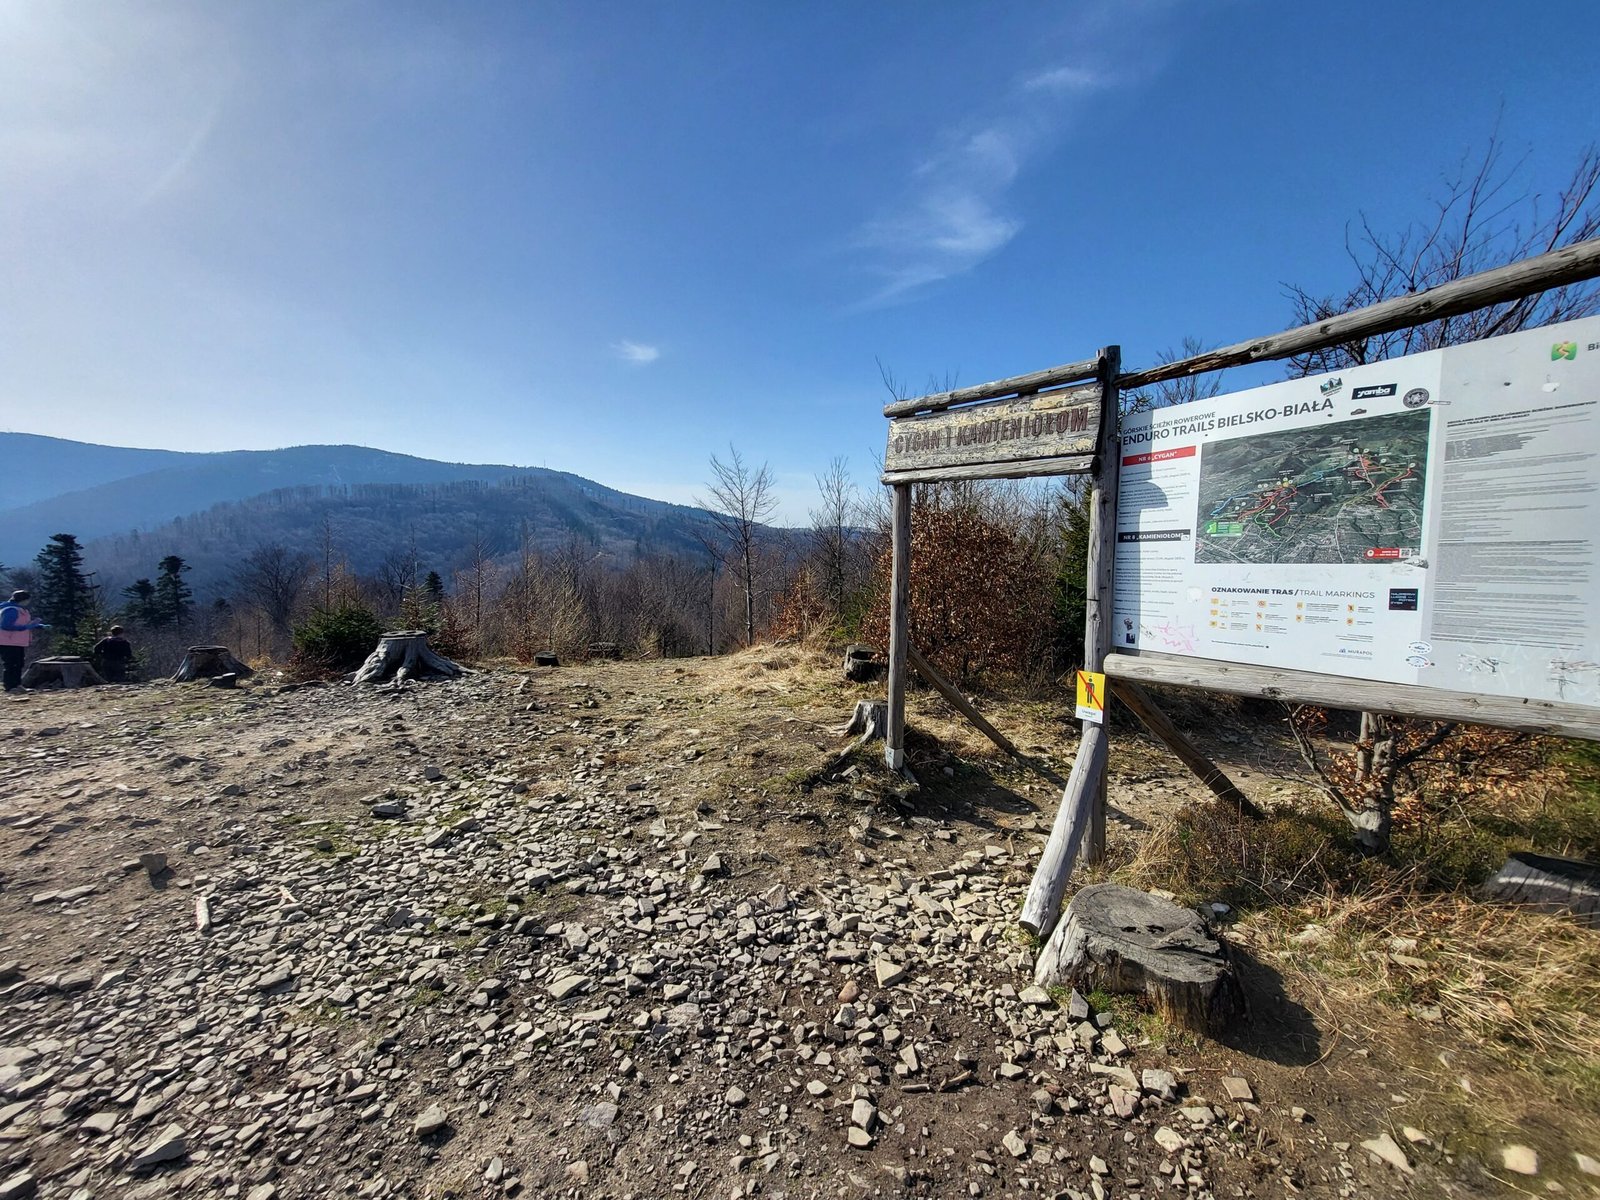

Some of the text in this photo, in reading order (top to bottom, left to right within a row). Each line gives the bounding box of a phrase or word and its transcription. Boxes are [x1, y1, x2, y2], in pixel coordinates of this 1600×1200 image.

[1122, 398, 1334, 446] ENDURO TRAILS BIELSKO-BIAŁA
[1123, 411, 1216, 435] GÓRSKIE ŚCIEŻKI ROWEROWE
[894, 430, 941, 454] CYGAN
[1211, 586, 1270, 595] OZNAKOWANIE
[1271, 588, 1294, 596] TRAS
[1299, 589, 1323, 597] TRAIL
[1325, 590, 1375, 599] MARKINGS
